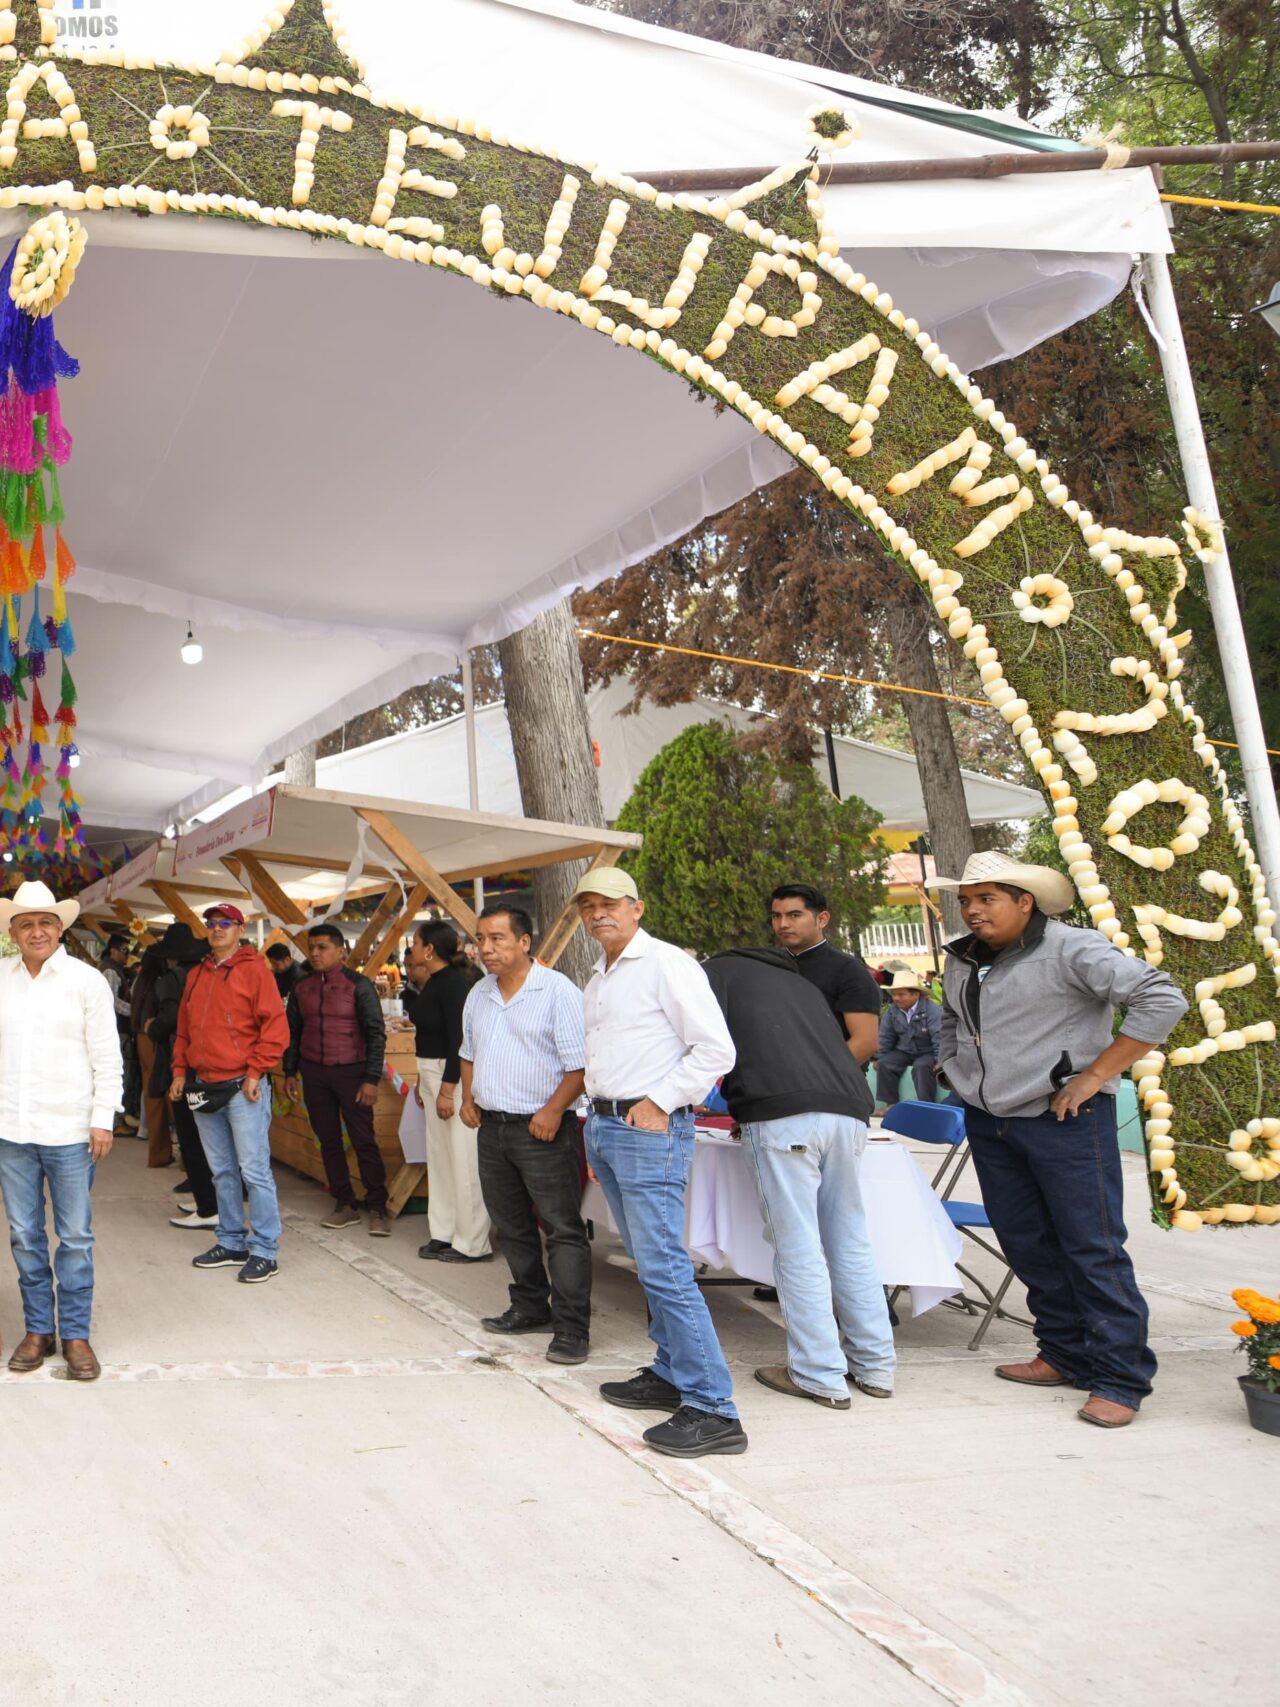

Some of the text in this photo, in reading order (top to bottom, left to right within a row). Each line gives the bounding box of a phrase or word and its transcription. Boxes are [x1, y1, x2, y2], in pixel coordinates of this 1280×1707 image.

[55, 15, 119, 37] OMOS
[0, 60, 97, 174] A
[271, 98, 1034, 559] TEJUPAM
[1051, 655, 1277, 1067] 2024
